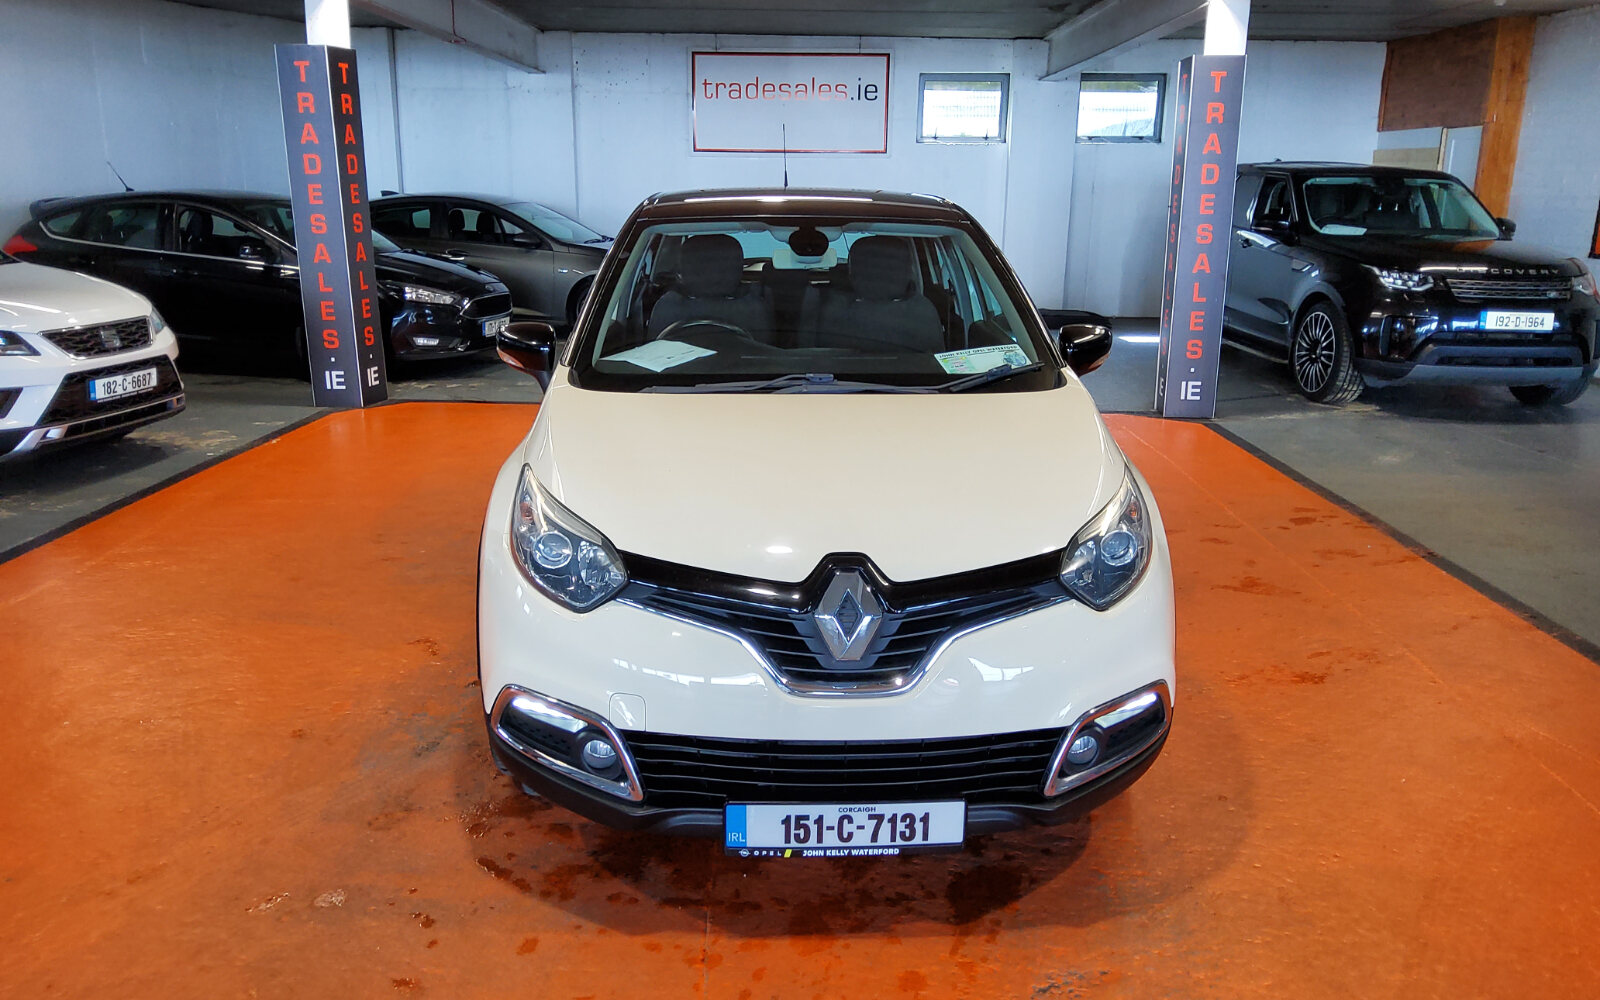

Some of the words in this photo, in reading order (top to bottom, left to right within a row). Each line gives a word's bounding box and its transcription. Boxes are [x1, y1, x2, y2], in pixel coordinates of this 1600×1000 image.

[702, 76, 878, 101] tradesales.ie
[1457, 267, 1559, 275] DISCOVERY
[1495, 316, 1545, 328] 192-D-1964
[102, 372, 152, 396] 182-C-6687
[780, 812, 930, 845] 151-C-7131
[728, 832, 746, 843] IRL
[826, 849, 850, 857] KELLY
[851, 848, 900, 856] WATERFORD
